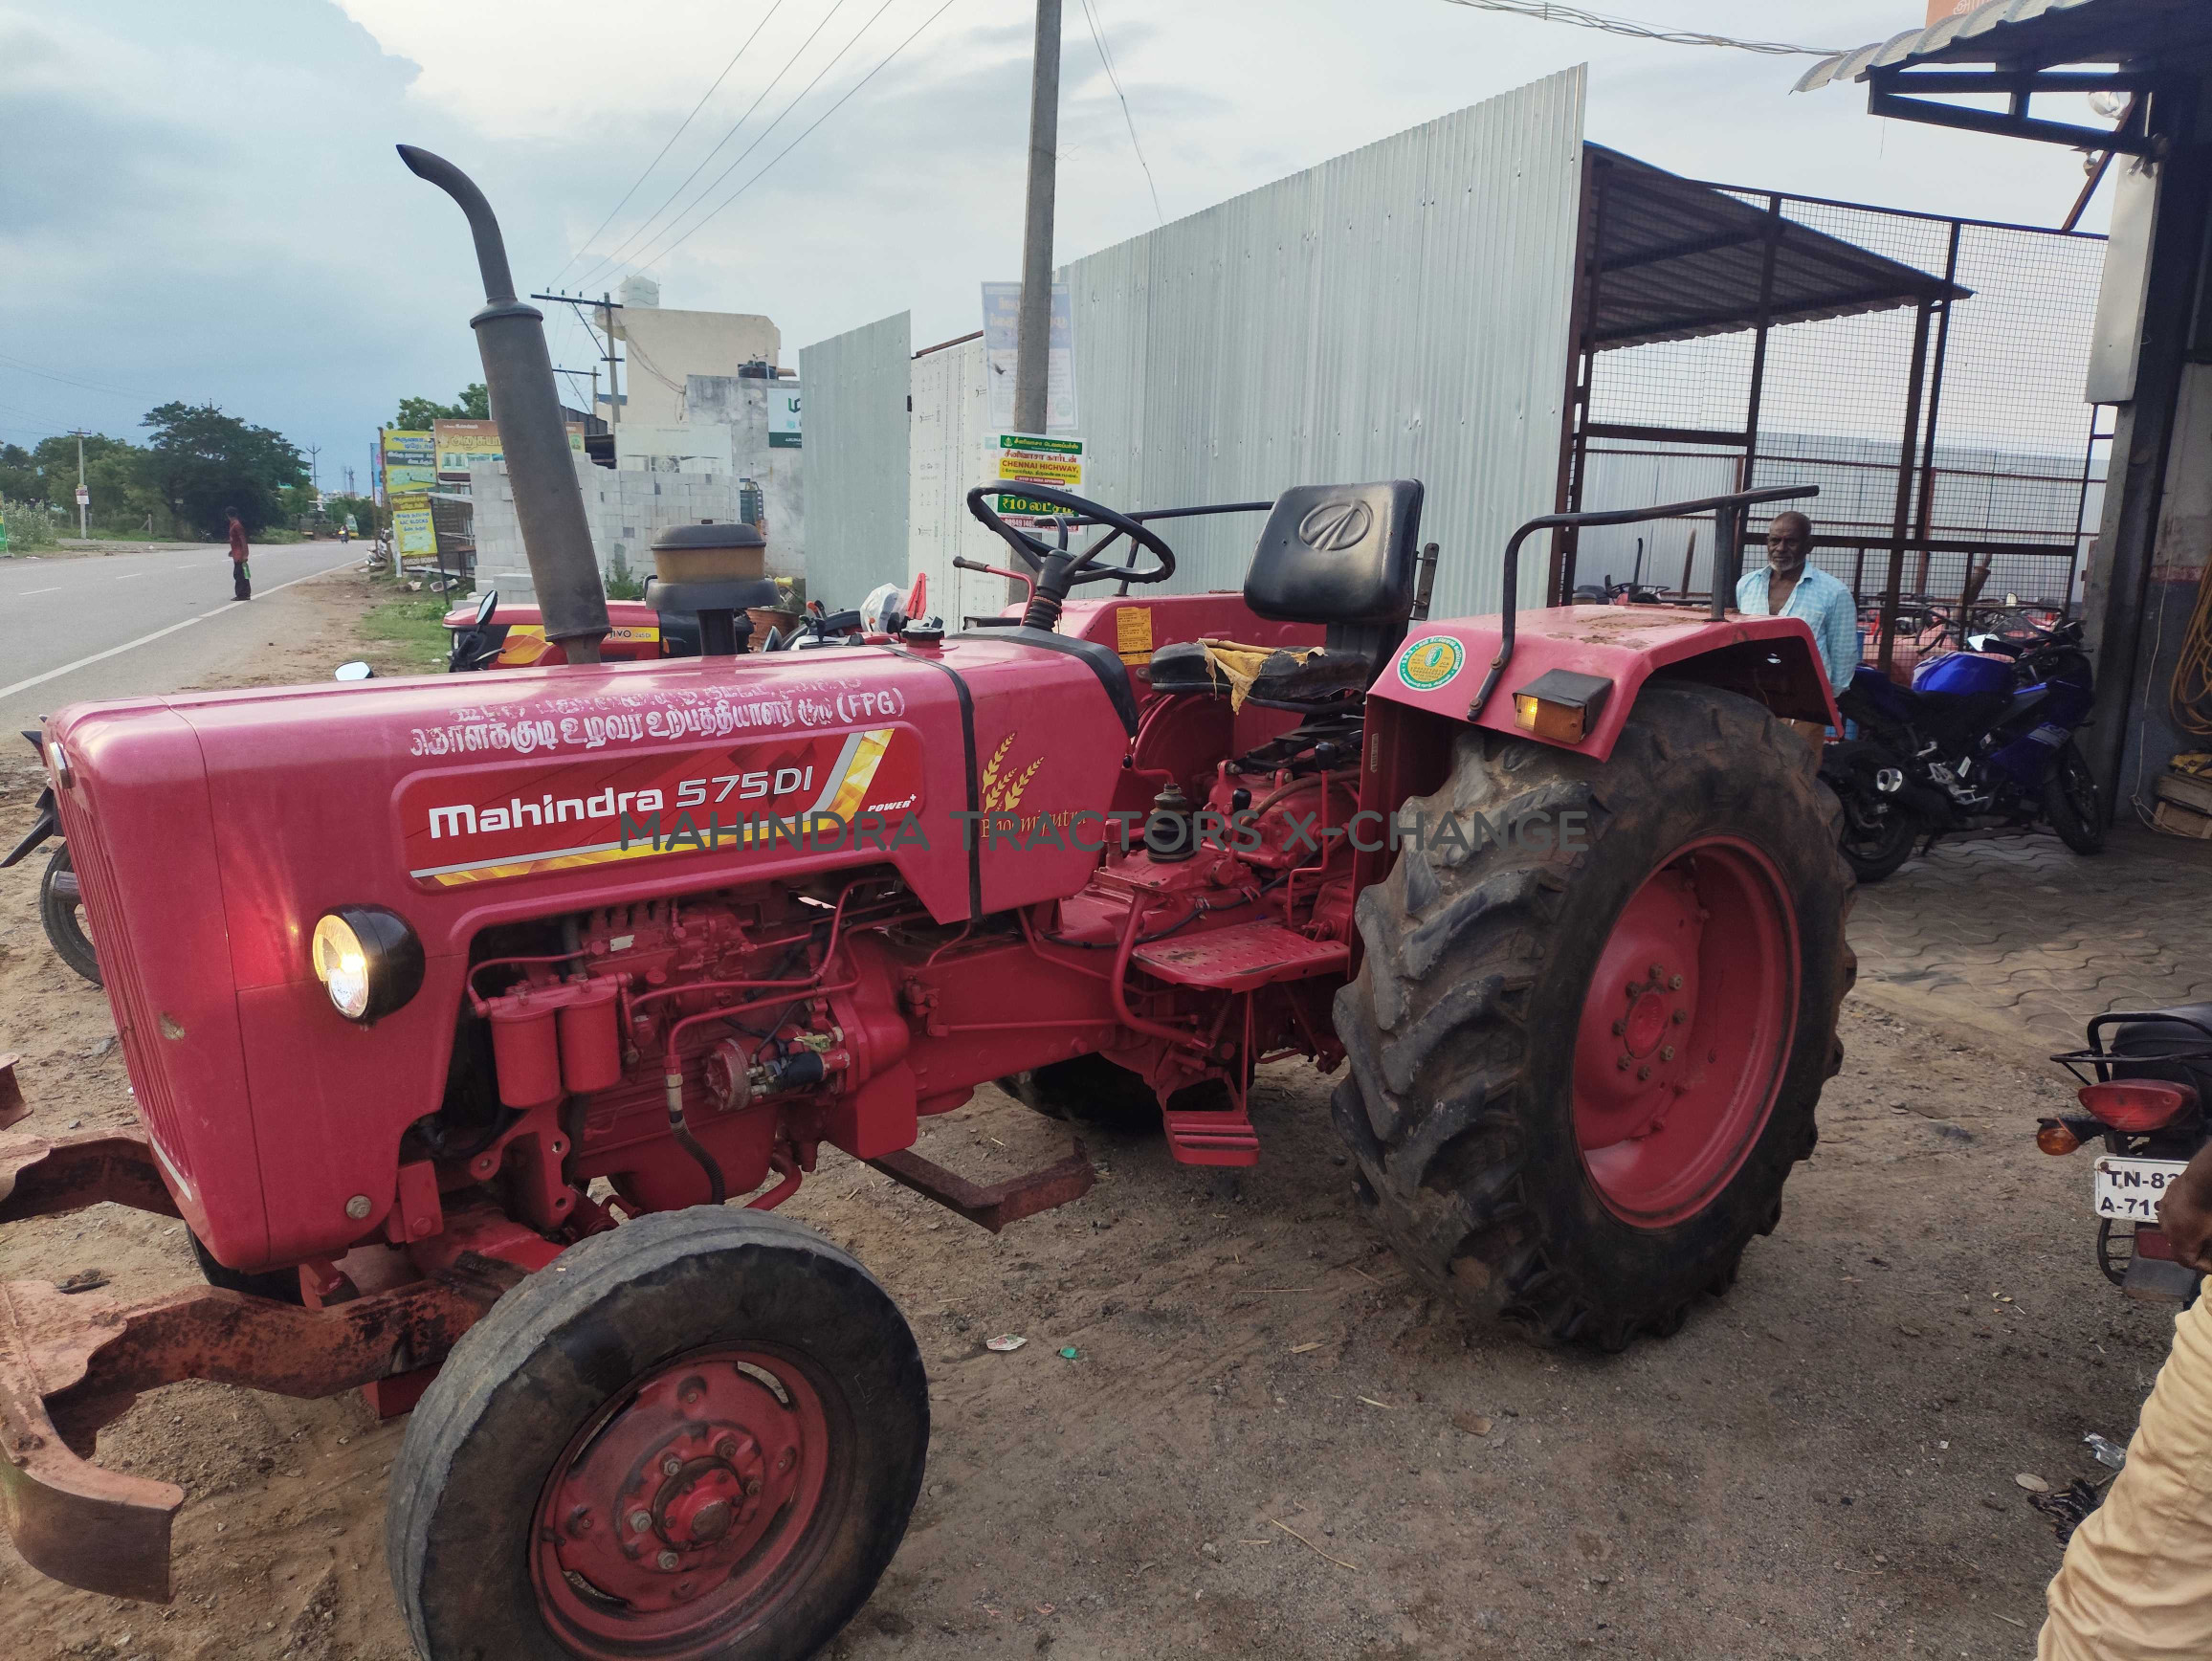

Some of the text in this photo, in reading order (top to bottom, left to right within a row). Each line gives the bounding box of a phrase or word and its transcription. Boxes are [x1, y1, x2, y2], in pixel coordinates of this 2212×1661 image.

[1002, 460, 1079, 474] CHENNAI HIGHWAY,
[1002, 497, 1027, 510] ₹10
